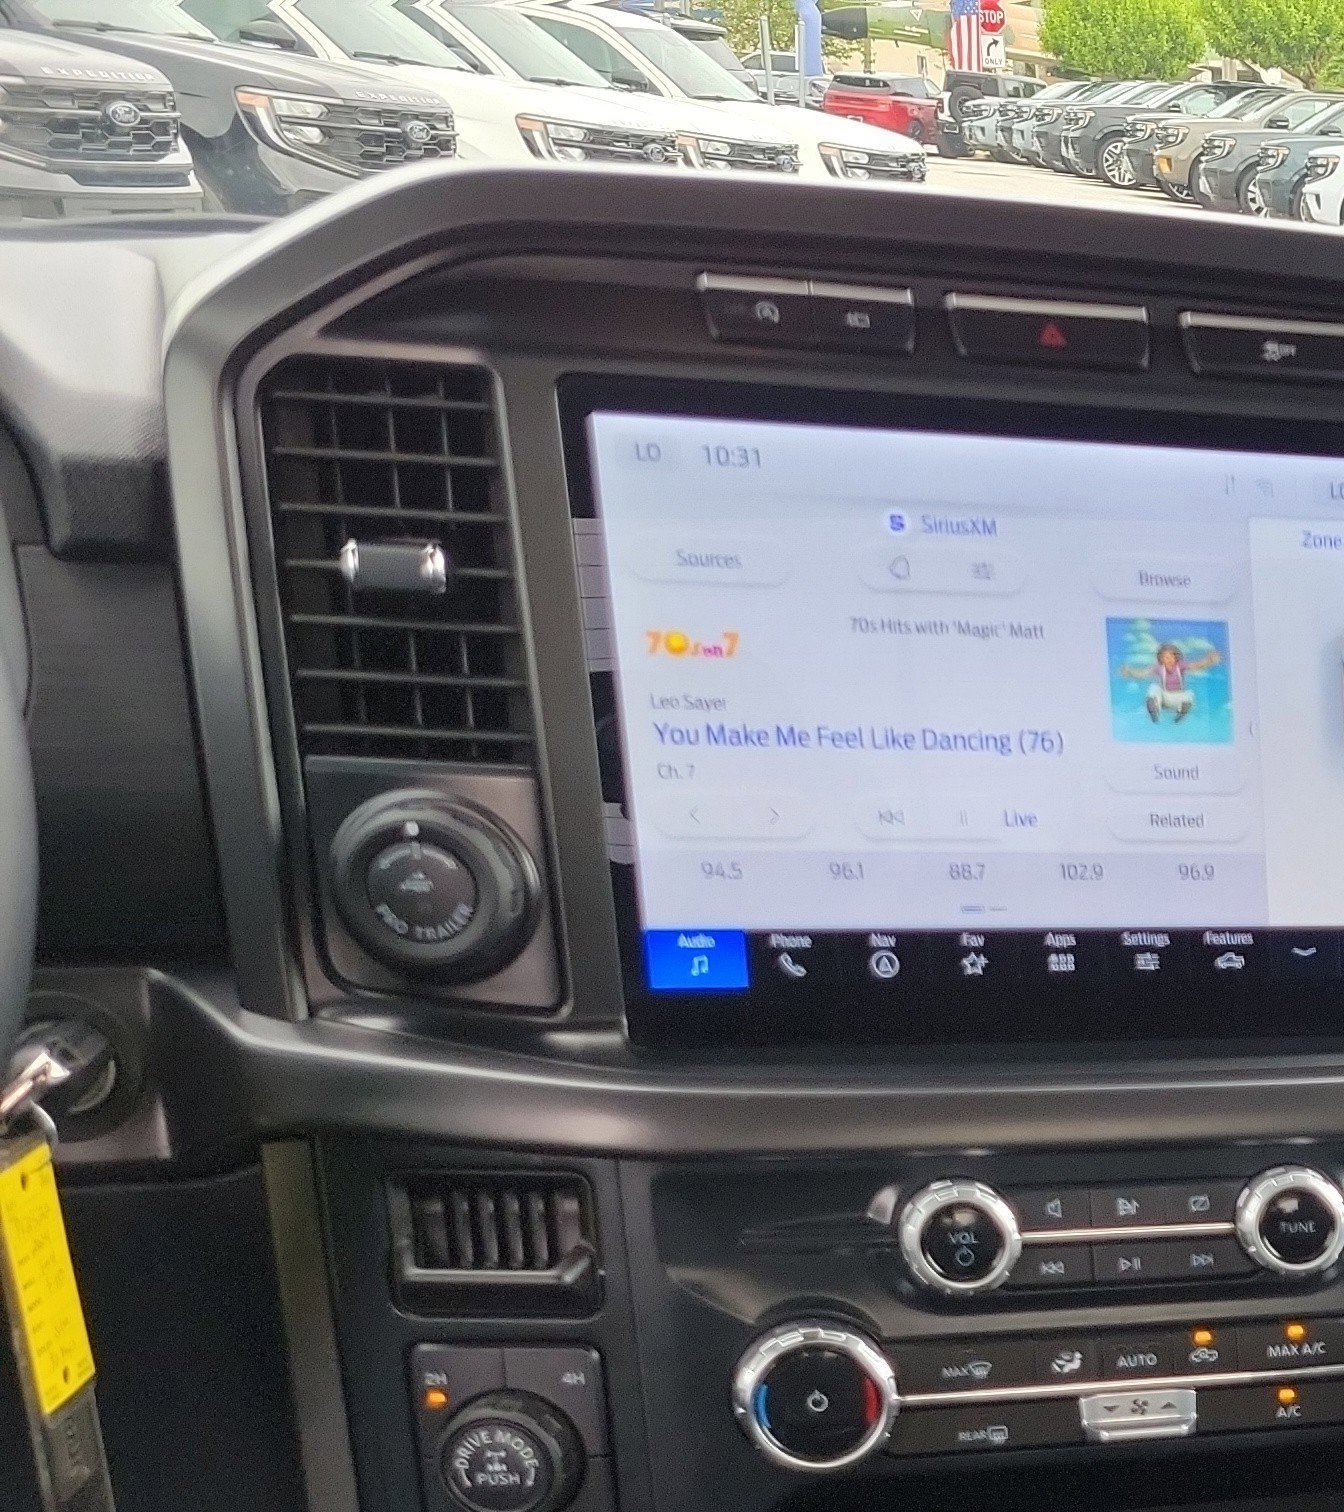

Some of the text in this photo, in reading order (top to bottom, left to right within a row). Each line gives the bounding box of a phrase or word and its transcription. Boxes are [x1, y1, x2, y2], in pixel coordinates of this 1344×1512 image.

[979, 10, 1004, 24] STOP
[635, 443, 661, 462] LO
[701, 445, 761, 467] 10:31
[922, 518, 996, 536] SiriusXM
[1302, 531, 1342, 550] Zone
[677, 549, 742, 568] Sources
[1139, 570, 1191, 588] Browse
[850, 617, 877, 632] 70s
[881, 618, 911, 634] Hits
[915, 620, 949, 636] with
[1010, 623, 1044, 639] Matt
[651, 694, 727, 713] Leo Sayer
[654, 723, 1064, 756] You Make Me Feel Like Dancing (76)
[657, 764, 696, 780] Ch. 7
[1153, 764, 1199, 781] Sound
[1003, 809, 1038, 828] Live
[1149, 813, 1204, 829] Related
[700, 863, 1215, 881] 94.5 96.1 88.7 102.9 96.9
[677, 931, 1254, 950] Audio Phone Nav Fav Apps Settings Features
[1281, 1221, 1316, 1234] TUNE
[949, 1234, 978, 1245] VOL
[1267, 1342, 1326, 1358] MAX A/C
[1117, 1353, 1157, 1367] AUTO
[424, 1371, 447, 1385] 2H
[561, 1371, 585, 1385] 4H
[942, 1366, 967, 1378] MAX
[1276, 1406, 1302, 1418] A/C
[959, 1430, 987, 1441] REAR
[454, 1429, 539, 1469] DRIVE MODE
[477, 1473, 520, 1485] PUSH
